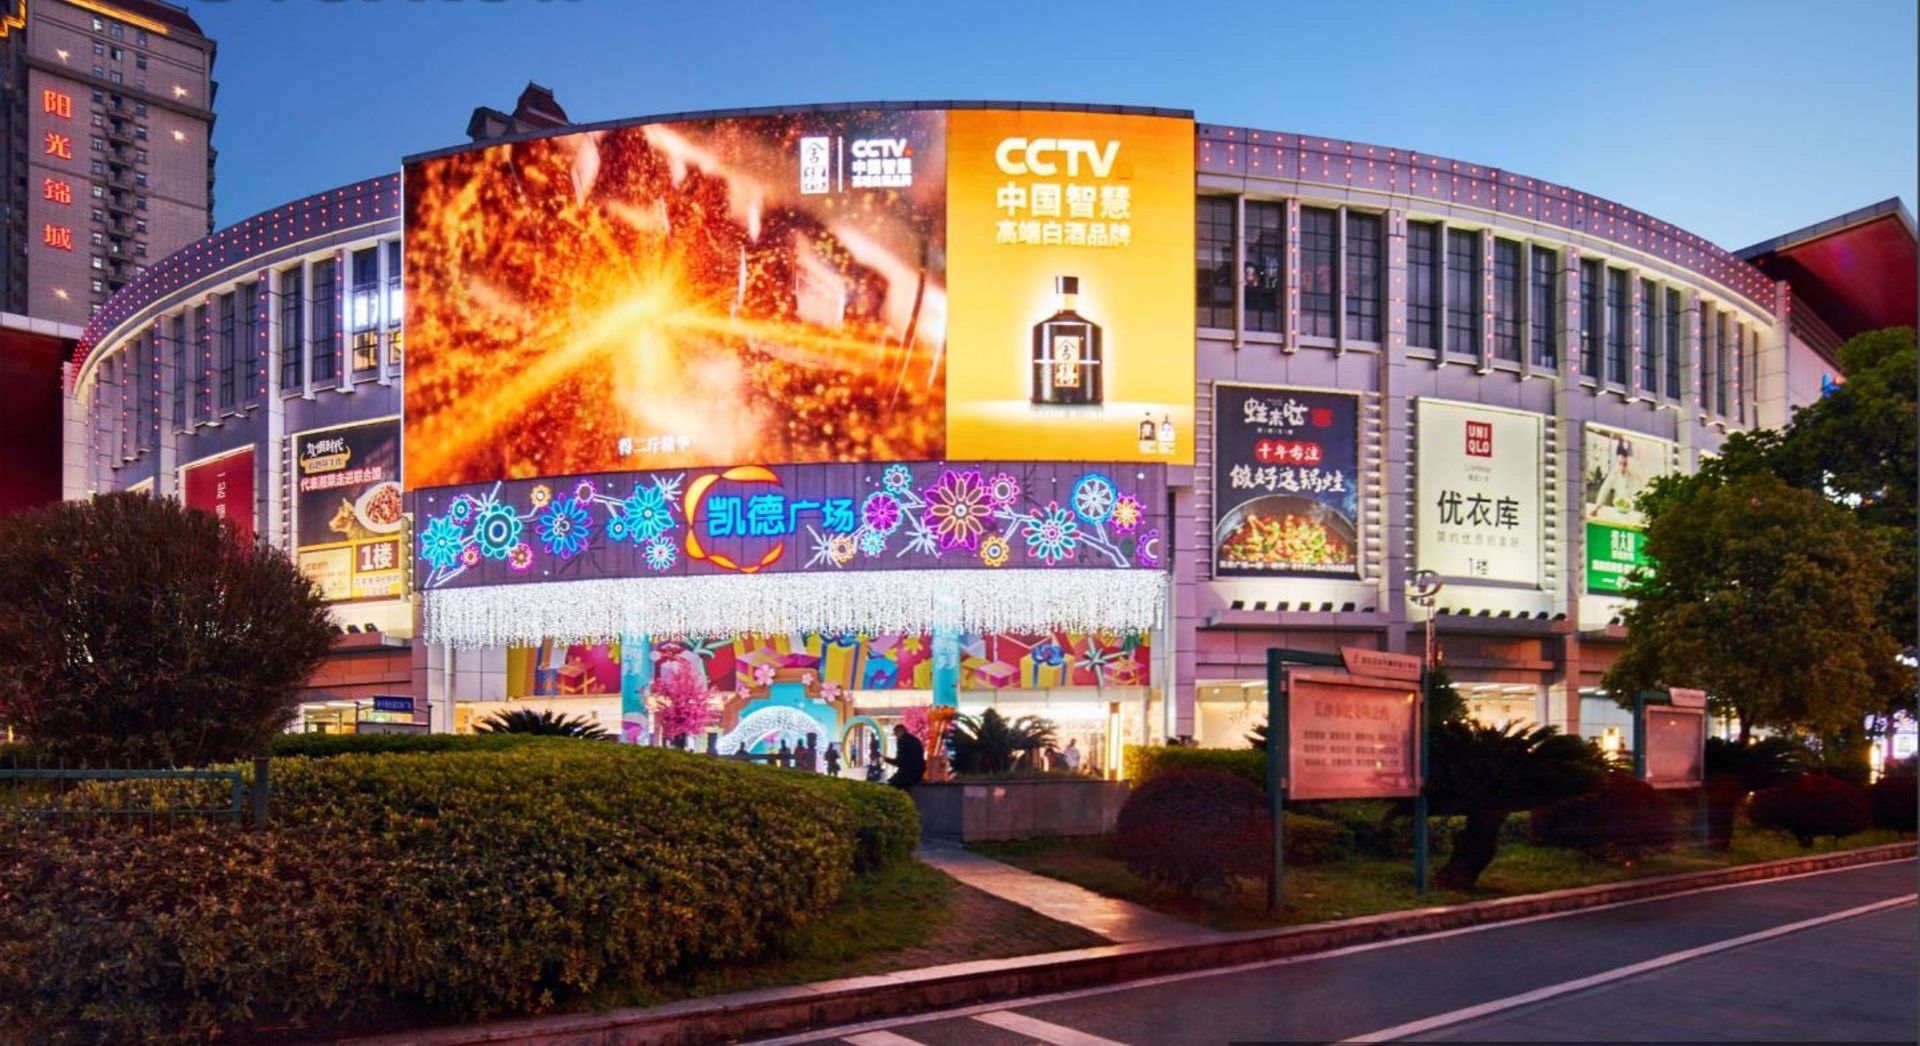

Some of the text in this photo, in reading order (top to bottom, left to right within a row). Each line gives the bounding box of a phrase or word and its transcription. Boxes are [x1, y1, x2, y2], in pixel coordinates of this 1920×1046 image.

[851, 138, 907, 158] CCTV
[995, 137, 1120, 178] CCTV
[43, 89, 72, 252] 阳光锦城
[996, 181, 1131, 219] 中国智慧
[995, 220, 1131, 247] 高端白酒品牌
[1467, 424, 1489, 439] UNI
[1467, 438, 1491, 455] QLO
[1258, 443, 1320, 461] 十年专注
[1230, 463, 1347, 493] 做好这锅蛙
[707, 494, 857, 537] 凯德广场
[1436, 489, 1520, 531] 优衣库
[361, 541, 393, 571] 1楼
[1468, 556, 1489, 576] 1楼
